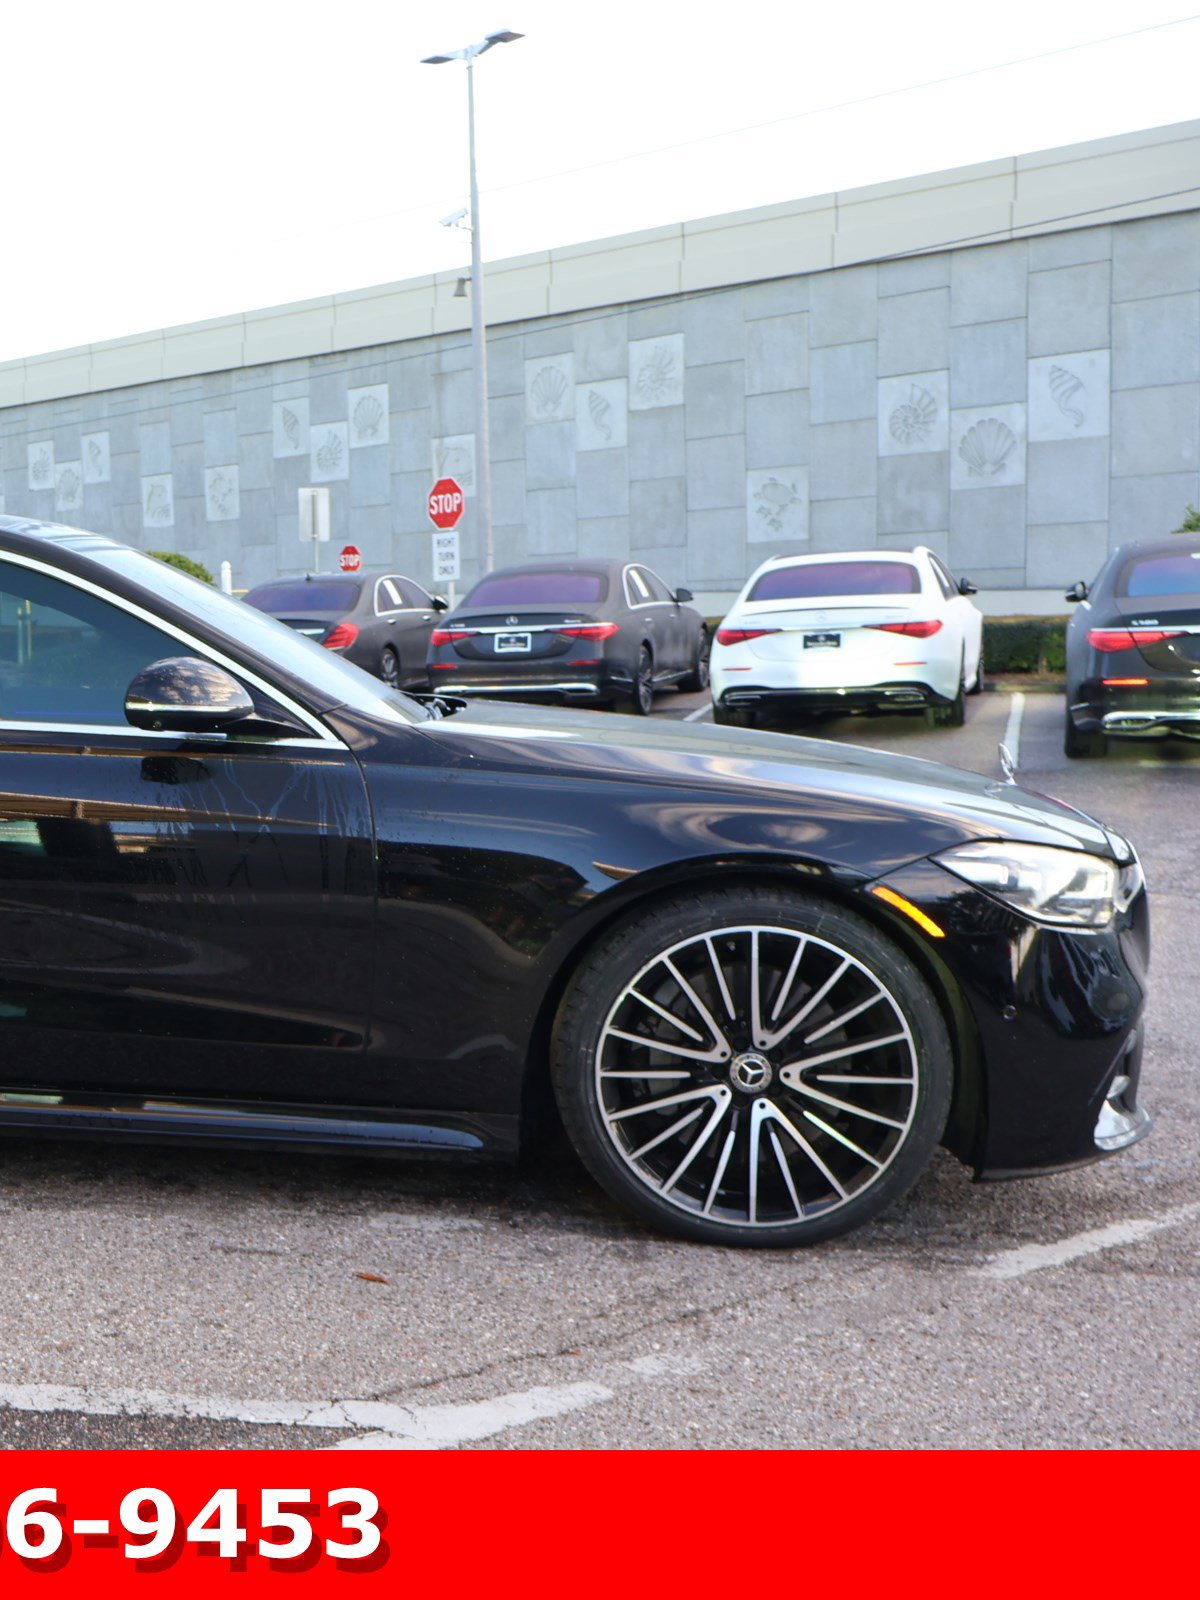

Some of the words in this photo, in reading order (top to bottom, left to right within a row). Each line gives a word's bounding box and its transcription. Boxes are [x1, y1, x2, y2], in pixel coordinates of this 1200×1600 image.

[429, 493, 461, 514] STOP
[437, 537, 455, 548] RIGHT
[339, 554, 360, 566] STOP
[438, 552, 455, 562] TURN
[438, 566, 455, 575] ONLY
